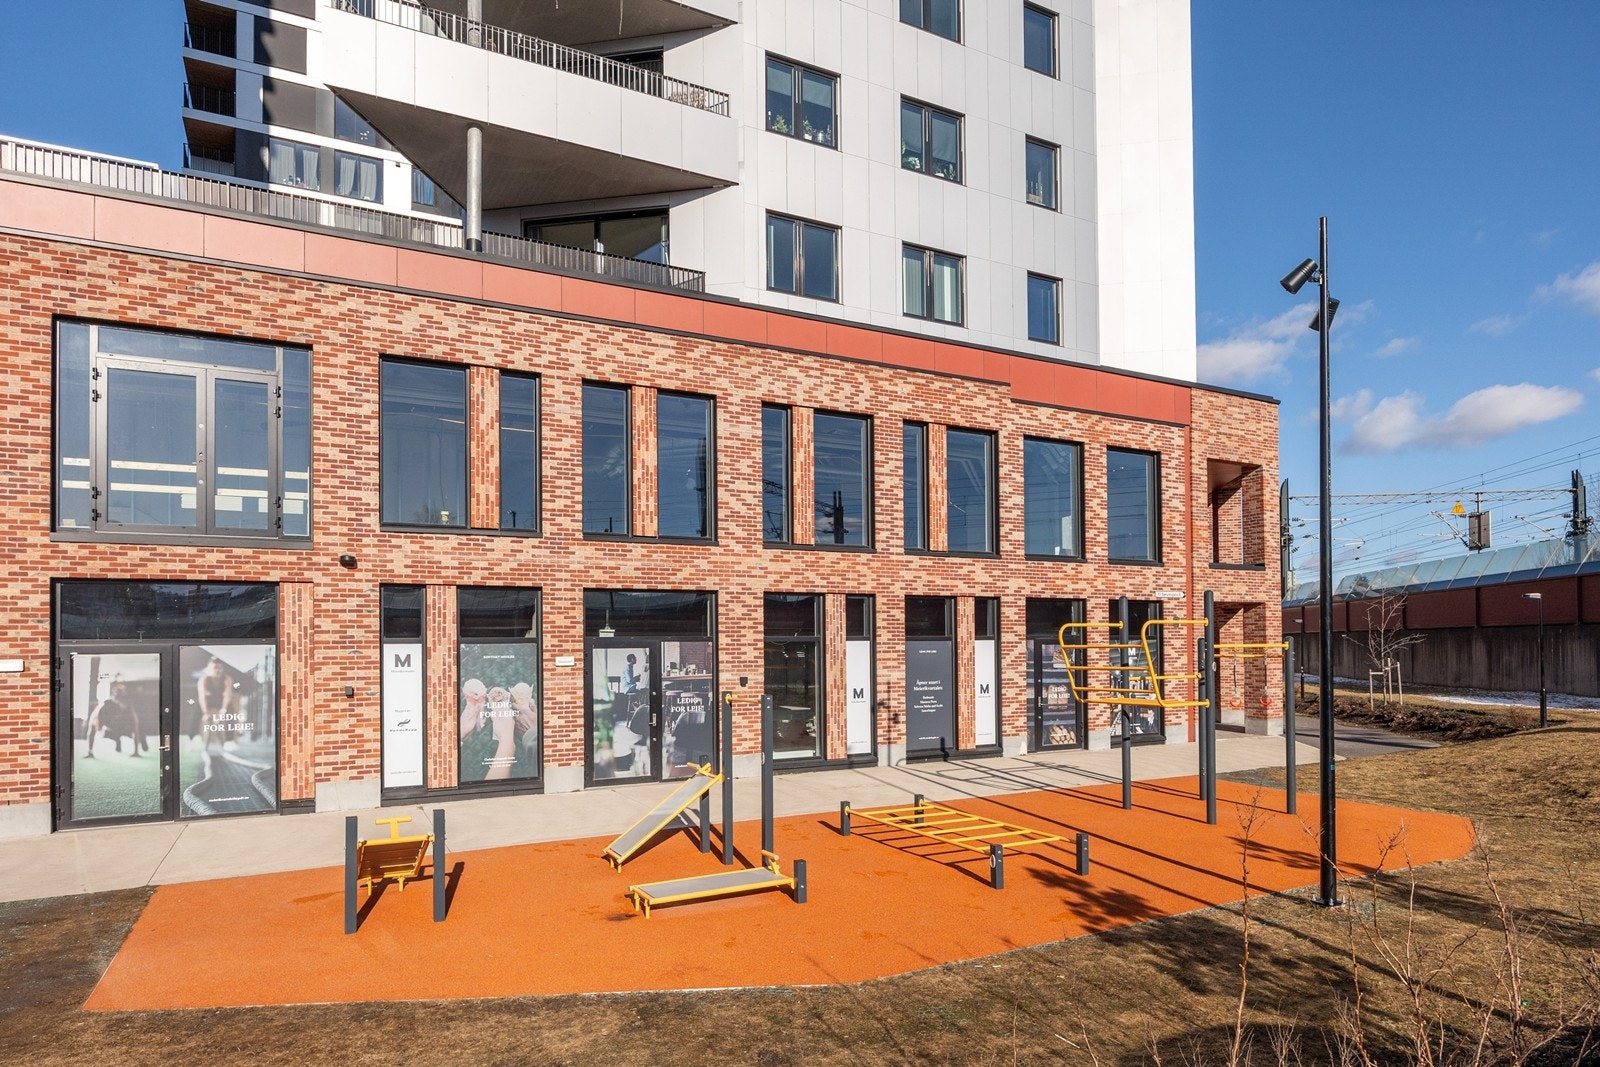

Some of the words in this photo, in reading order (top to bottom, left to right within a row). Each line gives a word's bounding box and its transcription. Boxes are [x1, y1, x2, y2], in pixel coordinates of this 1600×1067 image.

[394, 653, 411, 667] M
[853, 687, 864, 699] M
[980, 683, 989, 694] M
[486, 701, 512, 709] LEDIG
[212, 713, 245, 721] LEDIG
[498, 710, 520, 718] LEIE!
[203, 724, 225, 732] FOR
[227, 723, 254, 731] LEIE!
